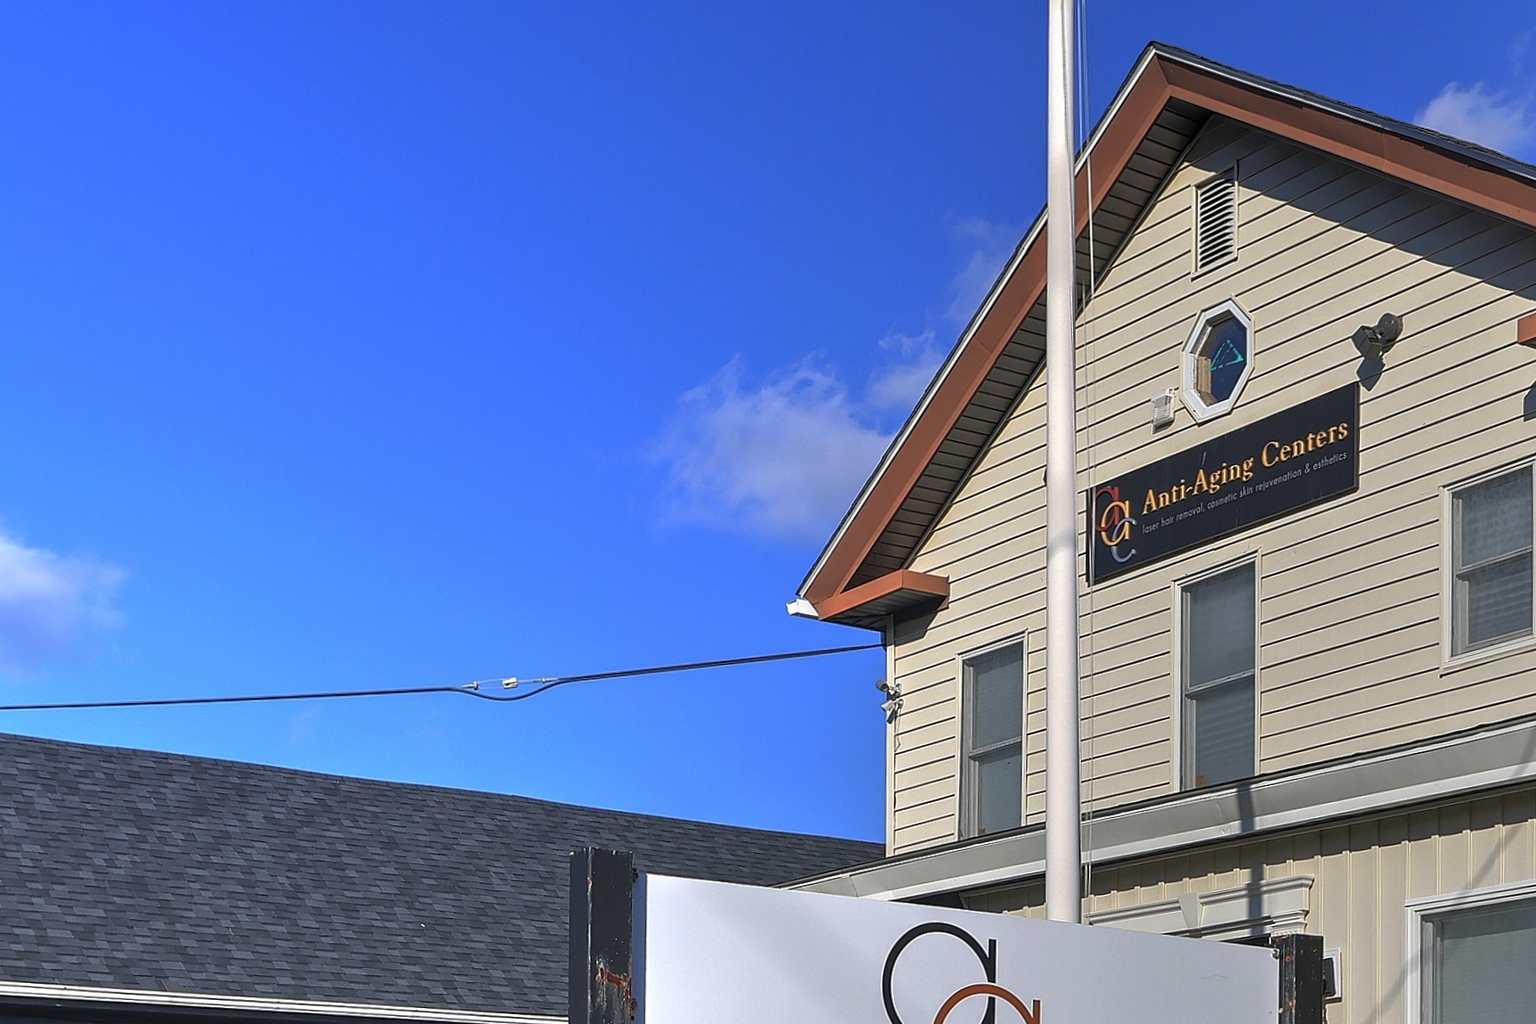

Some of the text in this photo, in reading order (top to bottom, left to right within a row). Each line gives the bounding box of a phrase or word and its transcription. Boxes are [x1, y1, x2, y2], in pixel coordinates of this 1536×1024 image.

[1141, 421, 1349, 516] Anti-Aging Centers
[1142, 451, 1348, 534] laser hair removal, cosmetic skin rejuvenation & esthetics
